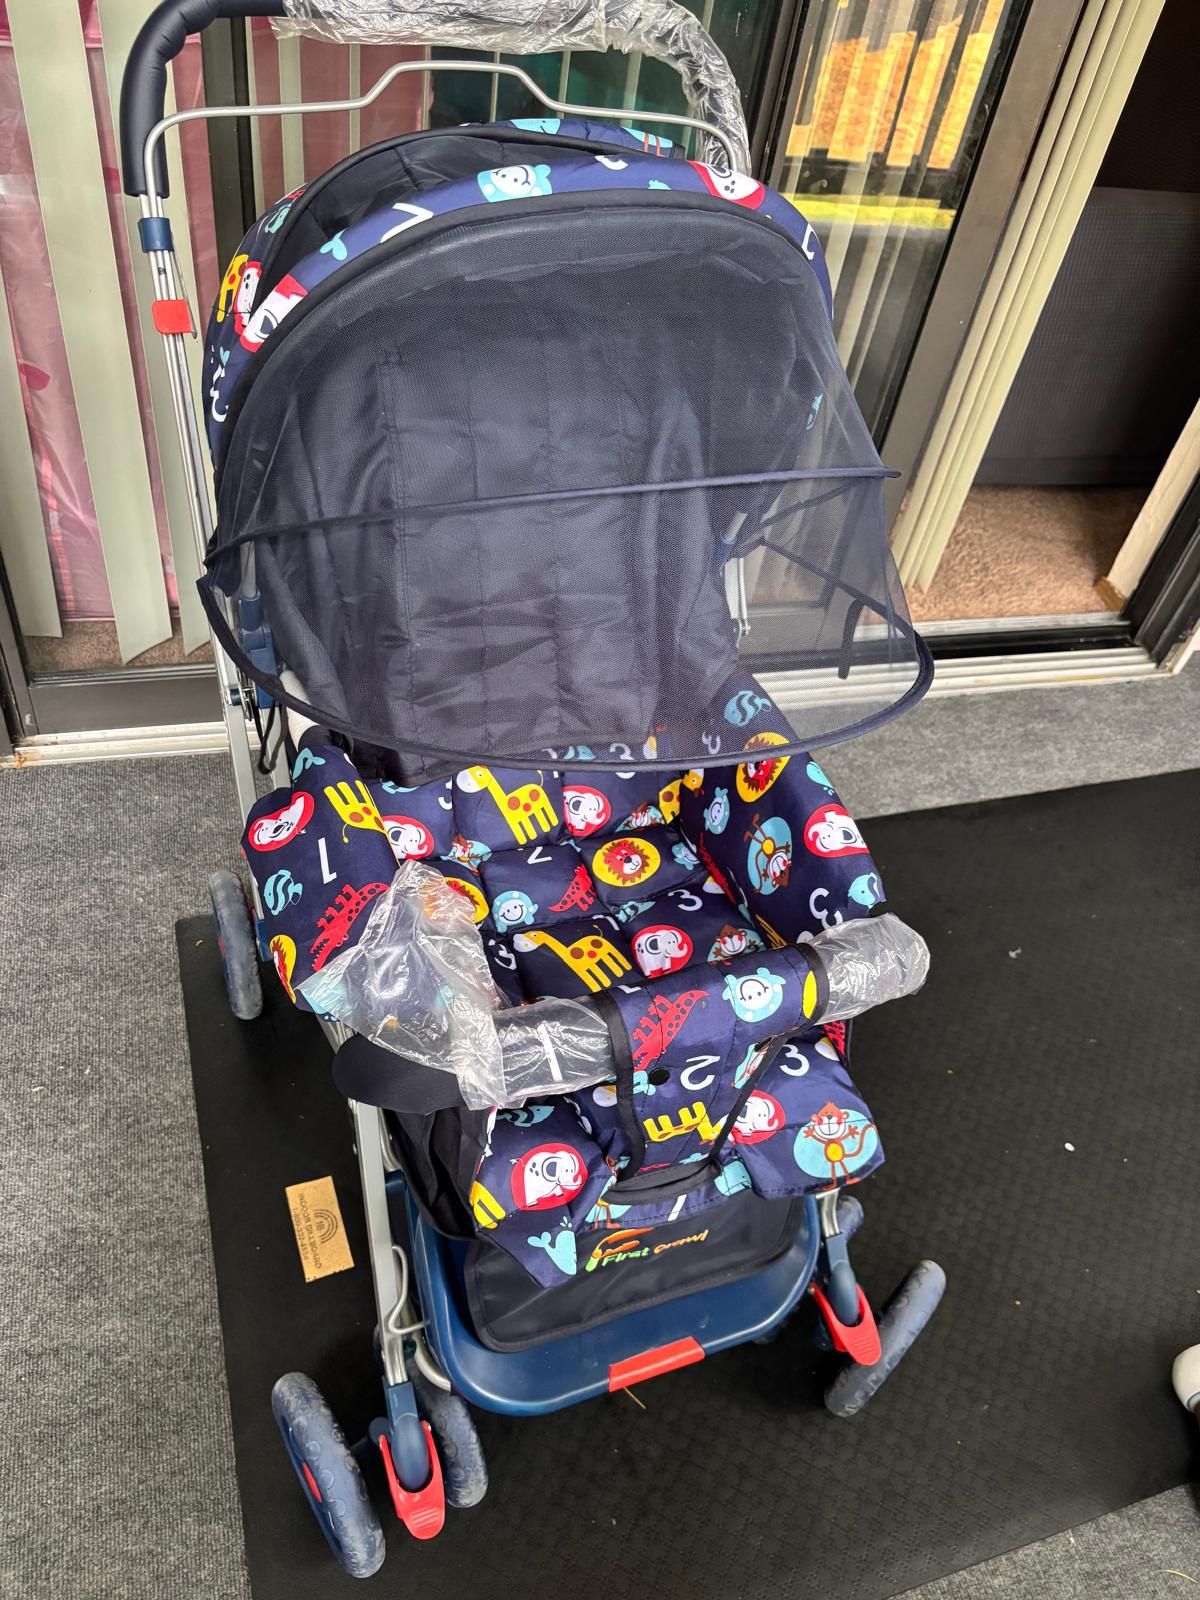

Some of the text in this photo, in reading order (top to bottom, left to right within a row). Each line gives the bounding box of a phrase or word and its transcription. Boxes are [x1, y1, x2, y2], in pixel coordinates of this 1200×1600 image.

[667, 889, 704, 912] 3
[679, 1055, 721, 1091] 2
[779, 1044, 810, 1077] 3
[299, 1194, 322, 1269] INDOOR BILLBOARD
